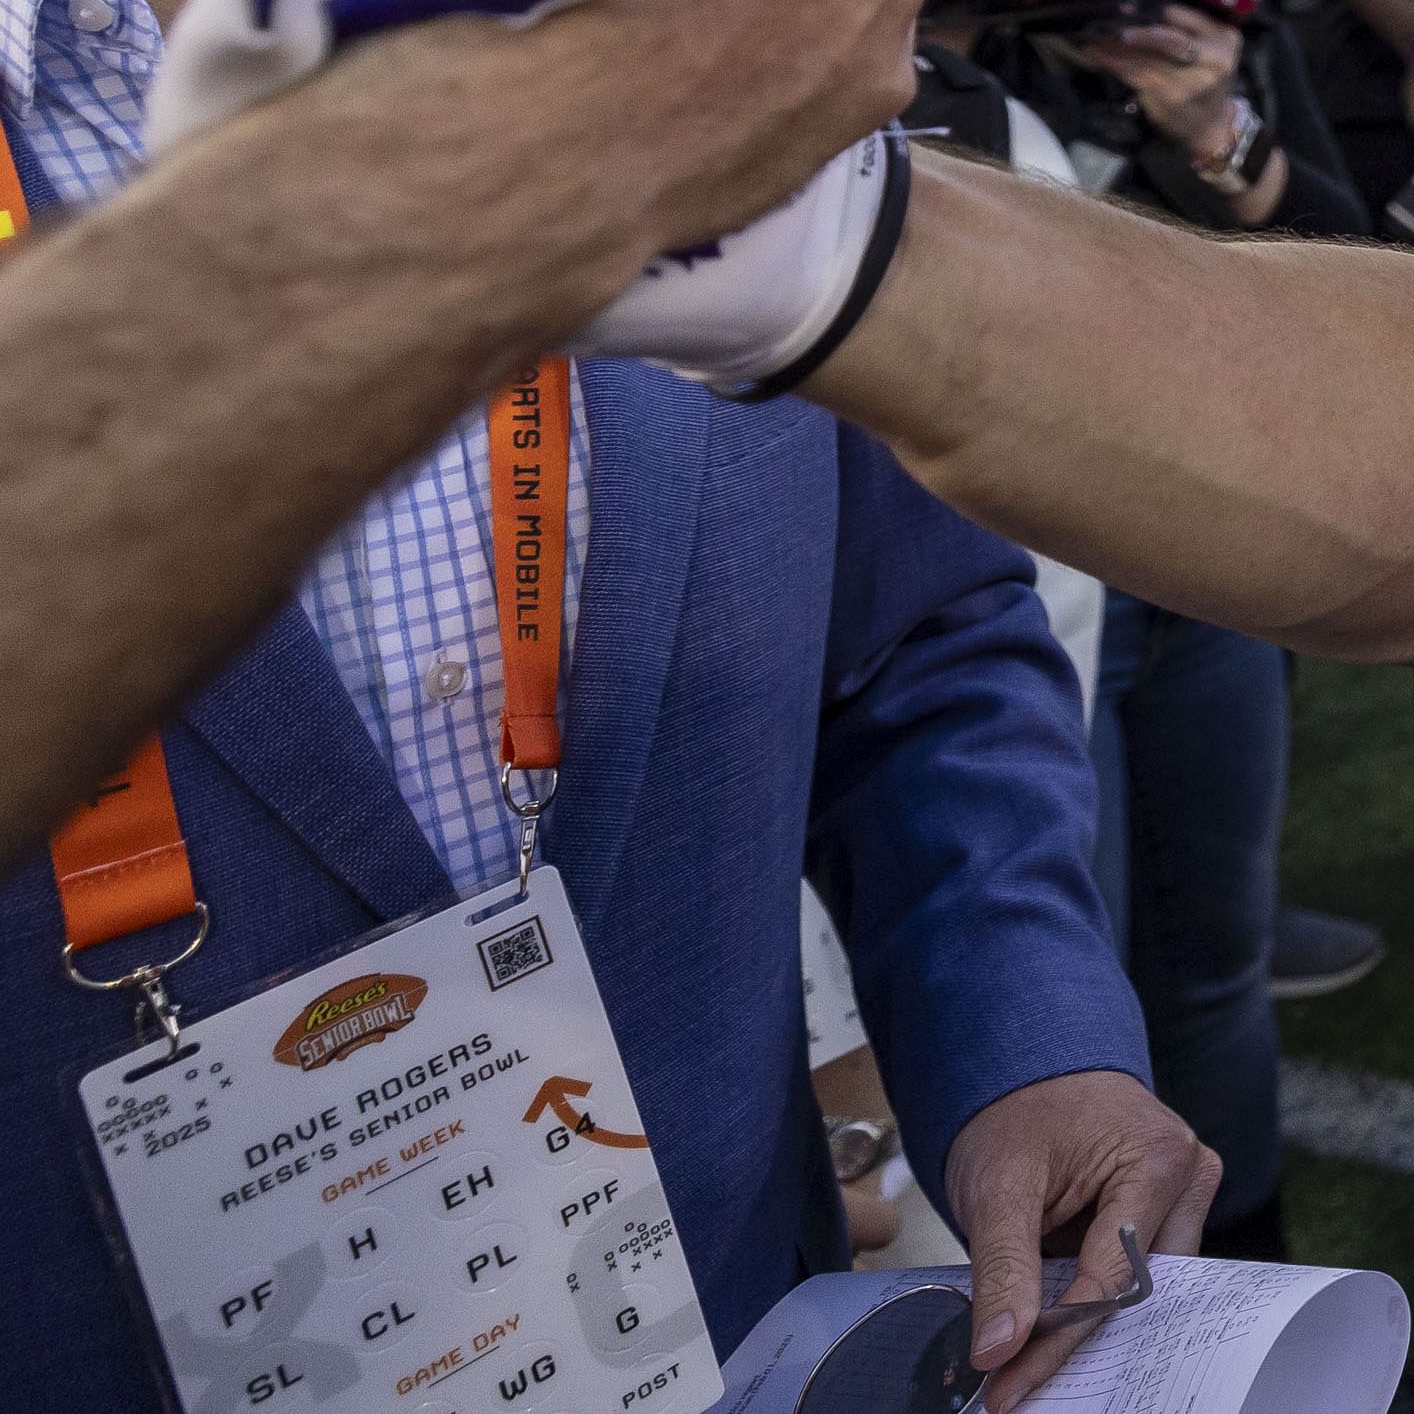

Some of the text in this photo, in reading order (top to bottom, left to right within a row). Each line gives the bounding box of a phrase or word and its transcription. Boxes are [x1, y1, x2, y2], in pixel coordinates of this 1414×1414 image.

[513, 464, 541, 500] IN
[514, 514, 542, 641] MOBILE
[306, 981, 387, 1031] Reese's
[299, 994, 412, 1068] SENIOR BOWL
[245, 1033, 492, 1169] DAVE ROGERS
[147, 1115, 212, 1158] 2025
[220, 1049, 530, 1212] REESE'S SENIOR BOWL
[321, 1119, 466, 1203] GAME WEEK
[441, 1165, 494, 1211] EH
[560, 1179, 619, 1227] PPF
[348, 1227, 378, 1260] H
[466, 1244, 517, 1283] PL
[219, 1279, 273, 1329] PF
[361, 1301, 415, 1340] CL
[615, 1306, 640, 1334] G
[395, 1313, 521, 1397] GAME DAY
[498, 1354, 556, 1401] WG
[246, 1363, 304, 1405] SL
[622, 1362, 681, 1409] POST
